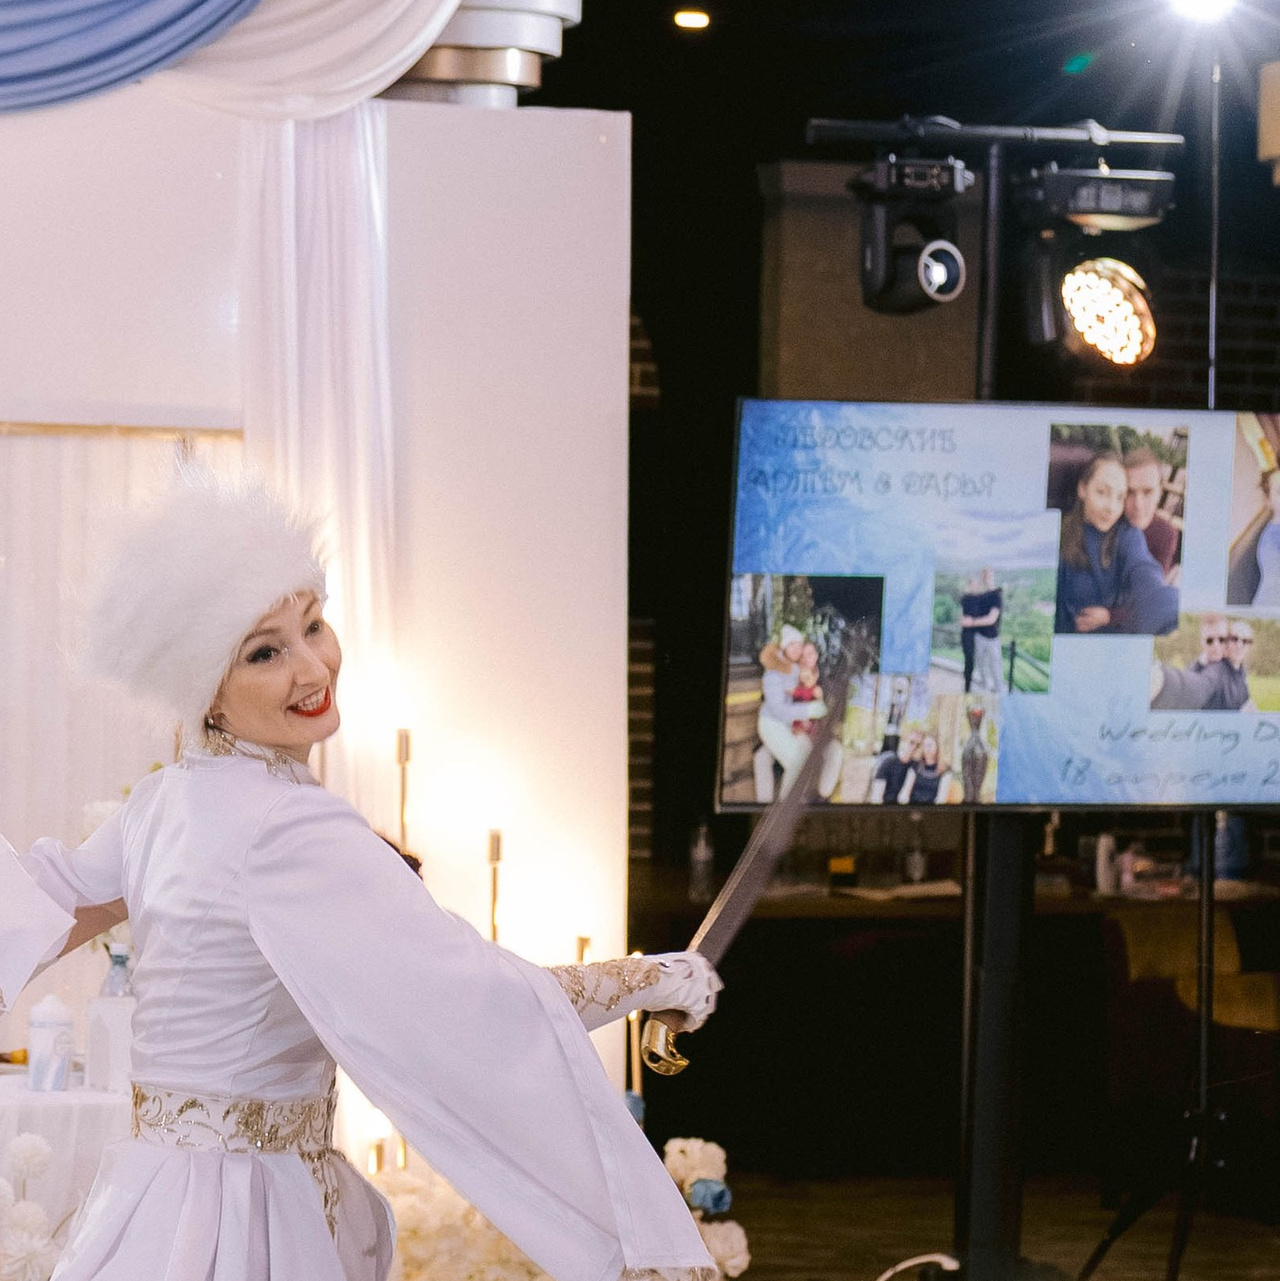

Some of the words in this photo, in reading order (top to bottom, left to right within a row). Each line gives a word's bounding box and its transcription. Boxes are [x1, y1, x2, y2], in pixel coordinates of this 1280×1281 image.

[1098, 718, 1242, 756] Wedding
[1253, 718, 1280, 743] D
[1060, 756, 1093, 786] 18
